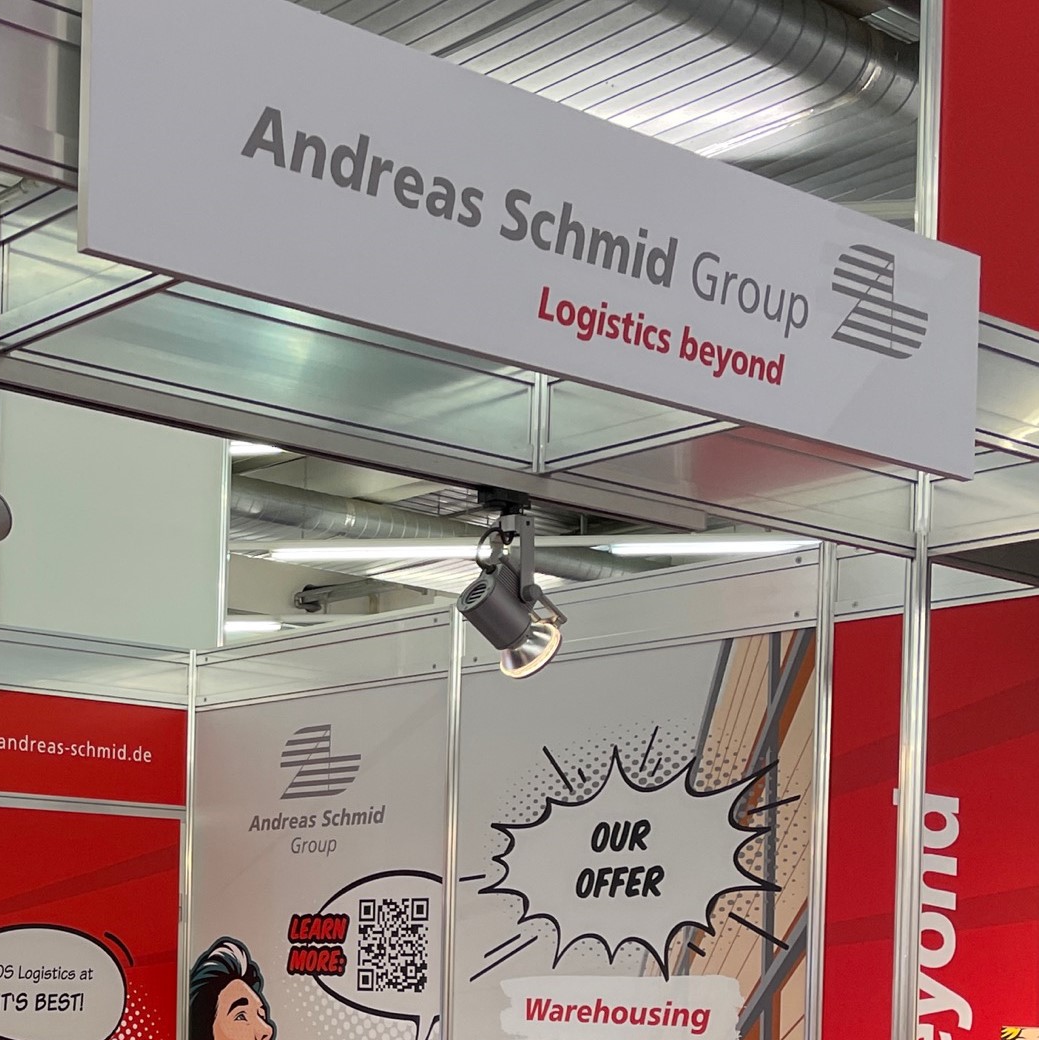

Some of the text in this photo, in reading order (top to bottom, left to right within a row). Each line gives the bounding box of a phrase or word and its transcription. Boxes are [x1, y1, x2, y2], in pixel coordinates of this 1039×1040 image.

[241, 106, 810, 338] Andreas Schmid Group
[538, 286, 784, 385] Logistics beyond
[249, 805, 385, 832] Andreas Schmid
[291, 837, 337, 857] Group
[591, 819, 651, 853] OUR
[576, 865, 665, 899] OFFER
[289, 915, 349, 942] LEARN
[18, 964, 76, 984] Logistics
[79, 966, 93, 981] at
[288, 948, 346, 975] MORE:
[35, 993, 84, 1012] BEST!
[525, 998, 711, 1035] Warehousing
